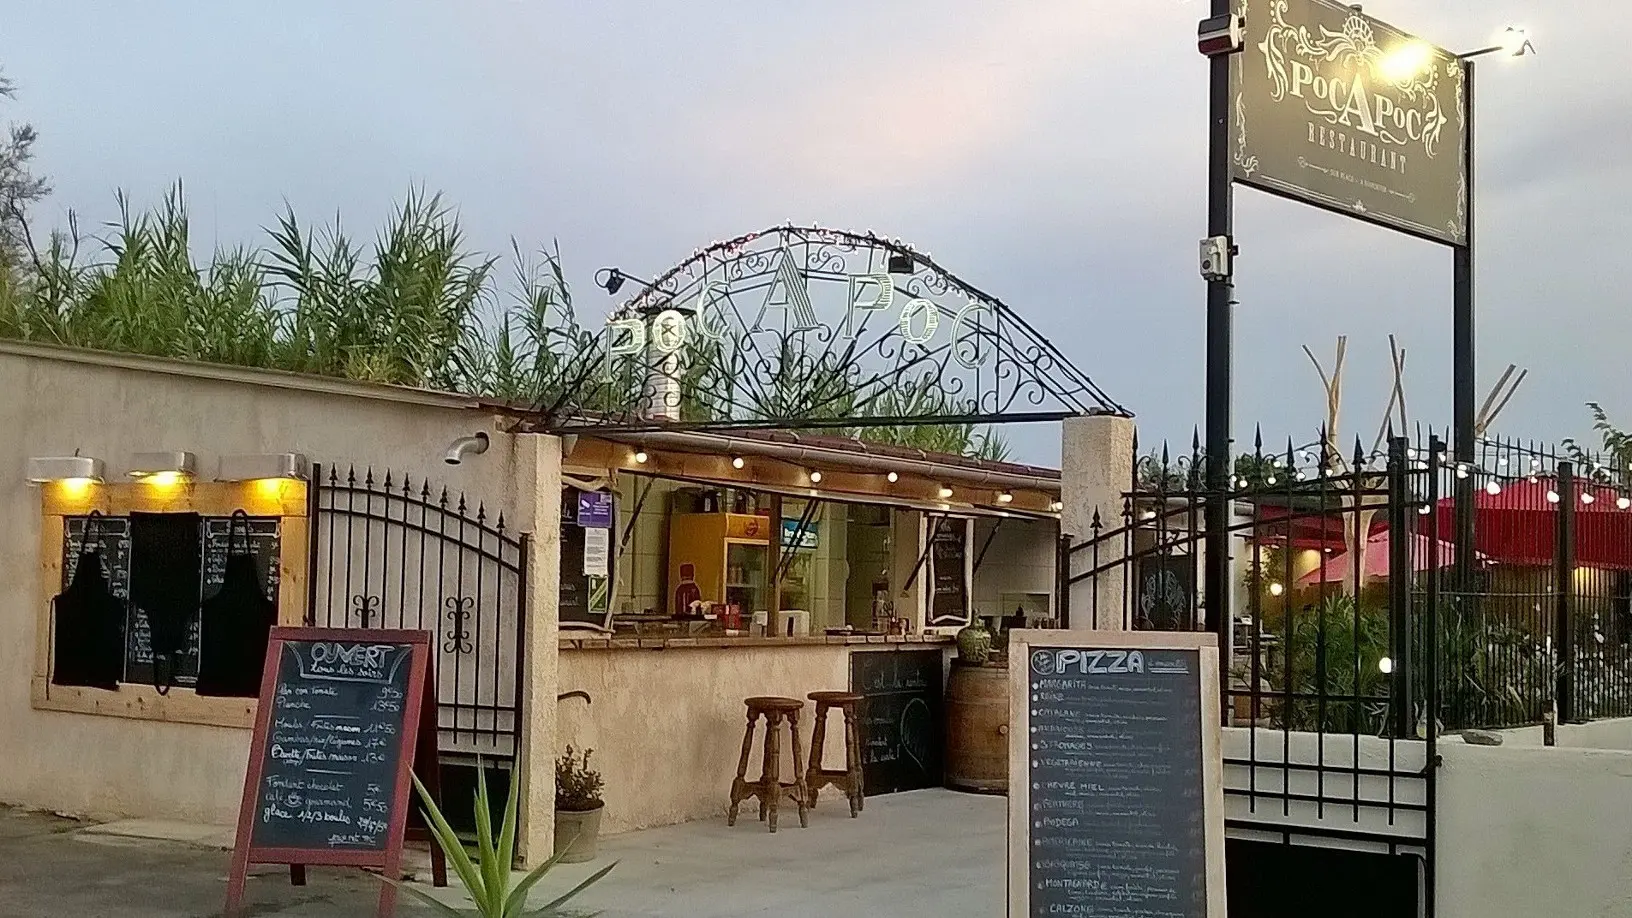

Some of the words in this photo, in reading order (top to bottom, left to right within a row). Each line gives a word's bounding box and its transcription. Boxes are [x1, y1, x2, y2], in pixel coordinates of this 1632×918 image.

[1307, 122, 1408, 175] RESTAURANT
[310, 643, 396, 668] OUVERT
[1055, 650, 1145, 675] PIZZA
[336, 664, 354, 677] les
